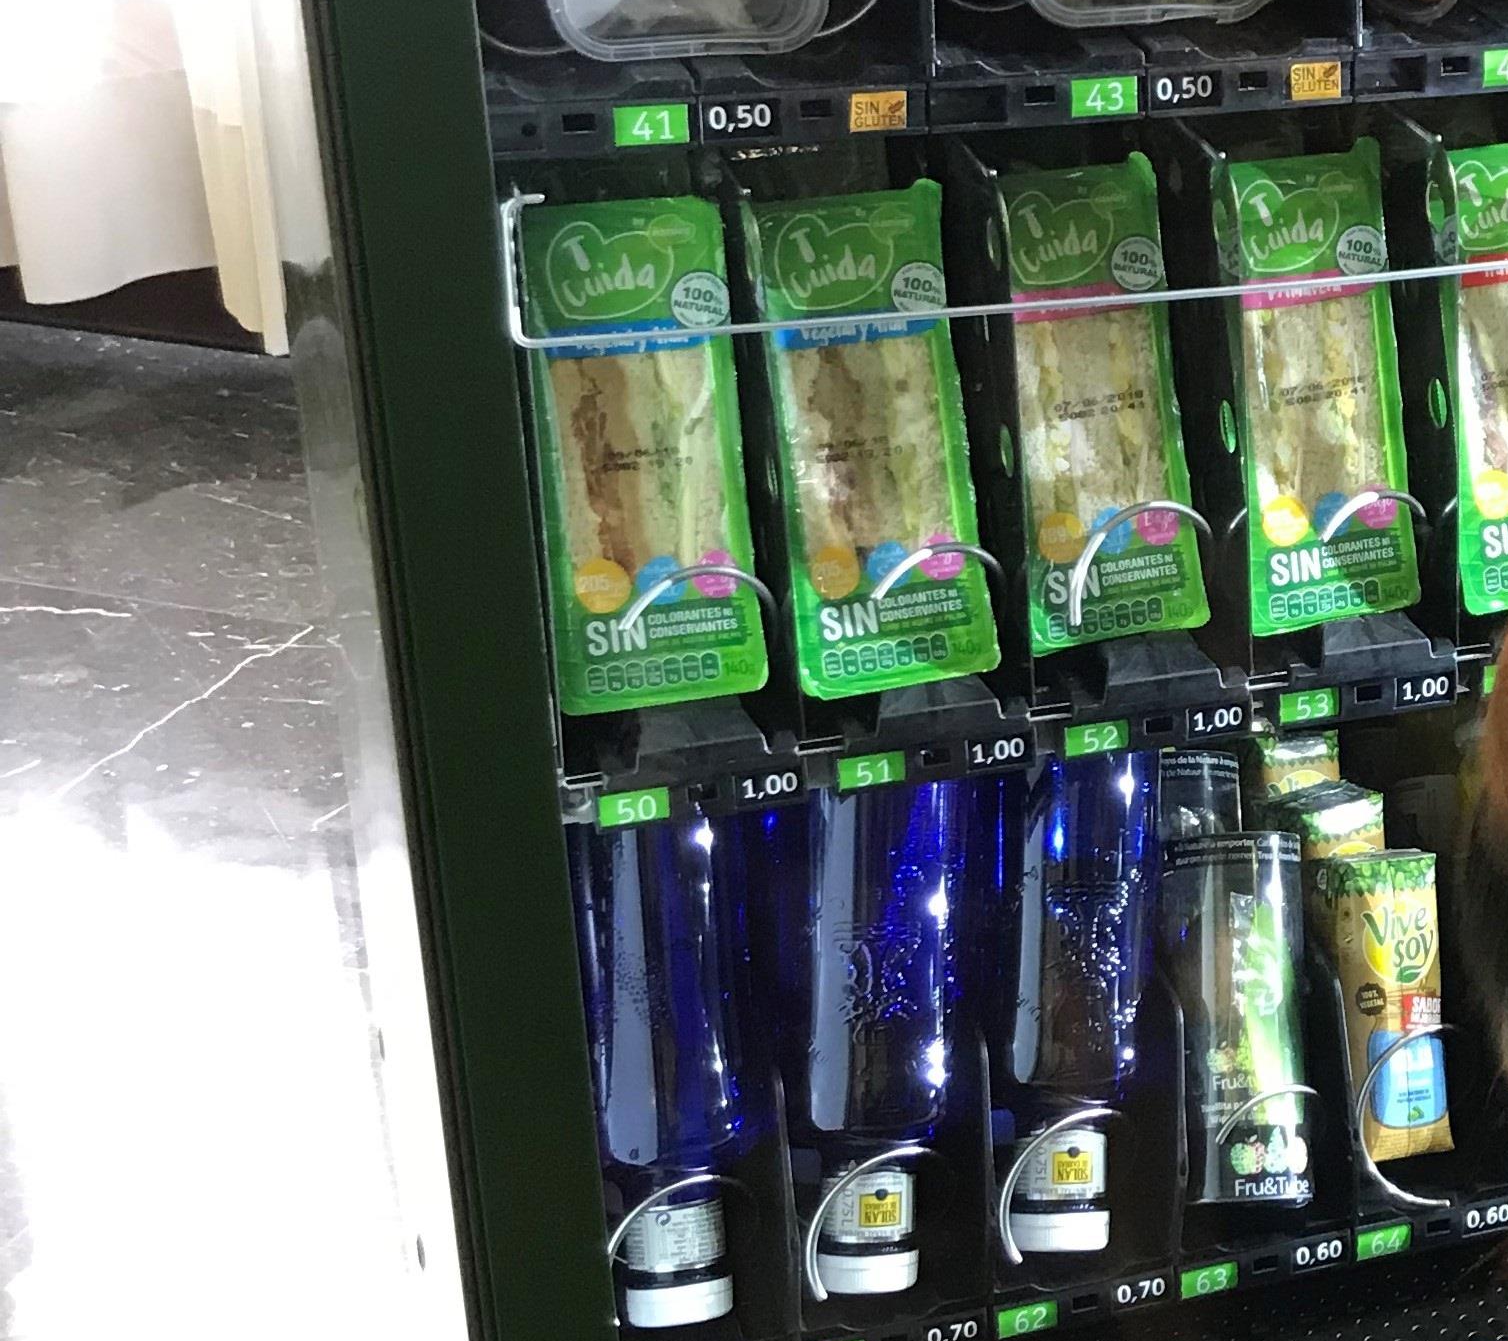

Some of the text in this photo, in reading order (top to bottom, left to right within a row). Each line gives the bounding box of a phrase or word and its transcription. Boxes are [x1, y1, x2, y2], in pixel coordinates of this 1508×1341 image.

[1157, 74, 1213, 103] 0,50
[1293, 67, 1317, 83] SIN
[1084, 81, 1126, 113] 43
[1291, 81, 1340, 99] GLUTEN
[708, 103, 772, 132] 0,50
[854, 97, 881, 113] SIN
[632, 109, 675, 143] 41
[854, 111, 905, 129] GLUTEN
[1459, 172, 1483, 207] T
[1018, 204, 1044, 240] T
[1249, 192, 1274, 227] T
[789, 227, 816, 263] T
[1019, 219, 1098, 273] Cuida
[1250, 208, 1324, 260] Cuida
[1346, 238, 1382, 257] 100%
[562, 235, 592, 272] T
[1338, 250, 1383, 267] NATURAL
[562, 252, 655, 307] Cuida
[790, 243, 876, 299] Cuida
[1113, 262, 1158, 277] NATURAL
[683, 285, 725, 305] 100%
[893, 288, 942, 305] NATURAL
[902, 275, 942, 295] 100%
[673, 299, 725, 317] NATURAL
[1322, 536, 1382, 557] COLORANTES
[1322, 547, 1395, 569] CONSERVANTES
[1100, 553, 1163, 574] COLORANTES
[1101, 563, 1178, 587] CONSERVANTES
[1270, 547, 1322, 587] SIN
[1048, 564, 1101, 605] SN
[878, 588, 947, 609] COLORANTES
[879, 599, 963, 623] CONSERVANTES
[647, 607, 721, 626] COLORANTES
[648, 617, 738, 640] CONSERVANTES
[820, 599, 879, 642] SIN
[586, 616, 648, 657] SIN
[1400, 676, 1451, 703] 1,00
[1191, 703, 1243, 733] 1,00
[1293, 693, 1332, 720] 53
[972, 736, 1026, 764] 1,00
[1081, 724, 1121, 751] 52
[741, 771, 799, 800] 1,00
[855, 760, 893, 787] 51
[616, 794, 659, 823] 50
[1361, 906, 1428, 947] Vive
[1392, 928, 1434, 968] soy
[1057, 1166, 1090, 1182] SOLAN
[864, 1211, 898, 1223] SOLAN
[1296, 1240, 1343, 1265] 0,60
[1371, 1228, 1404, 1254] 64
[1116, 1277, 1166, 1305] 0,70
[1195, 1266, 1229, 1294] 63
[1014, 1306, 1048, 1332] 62
